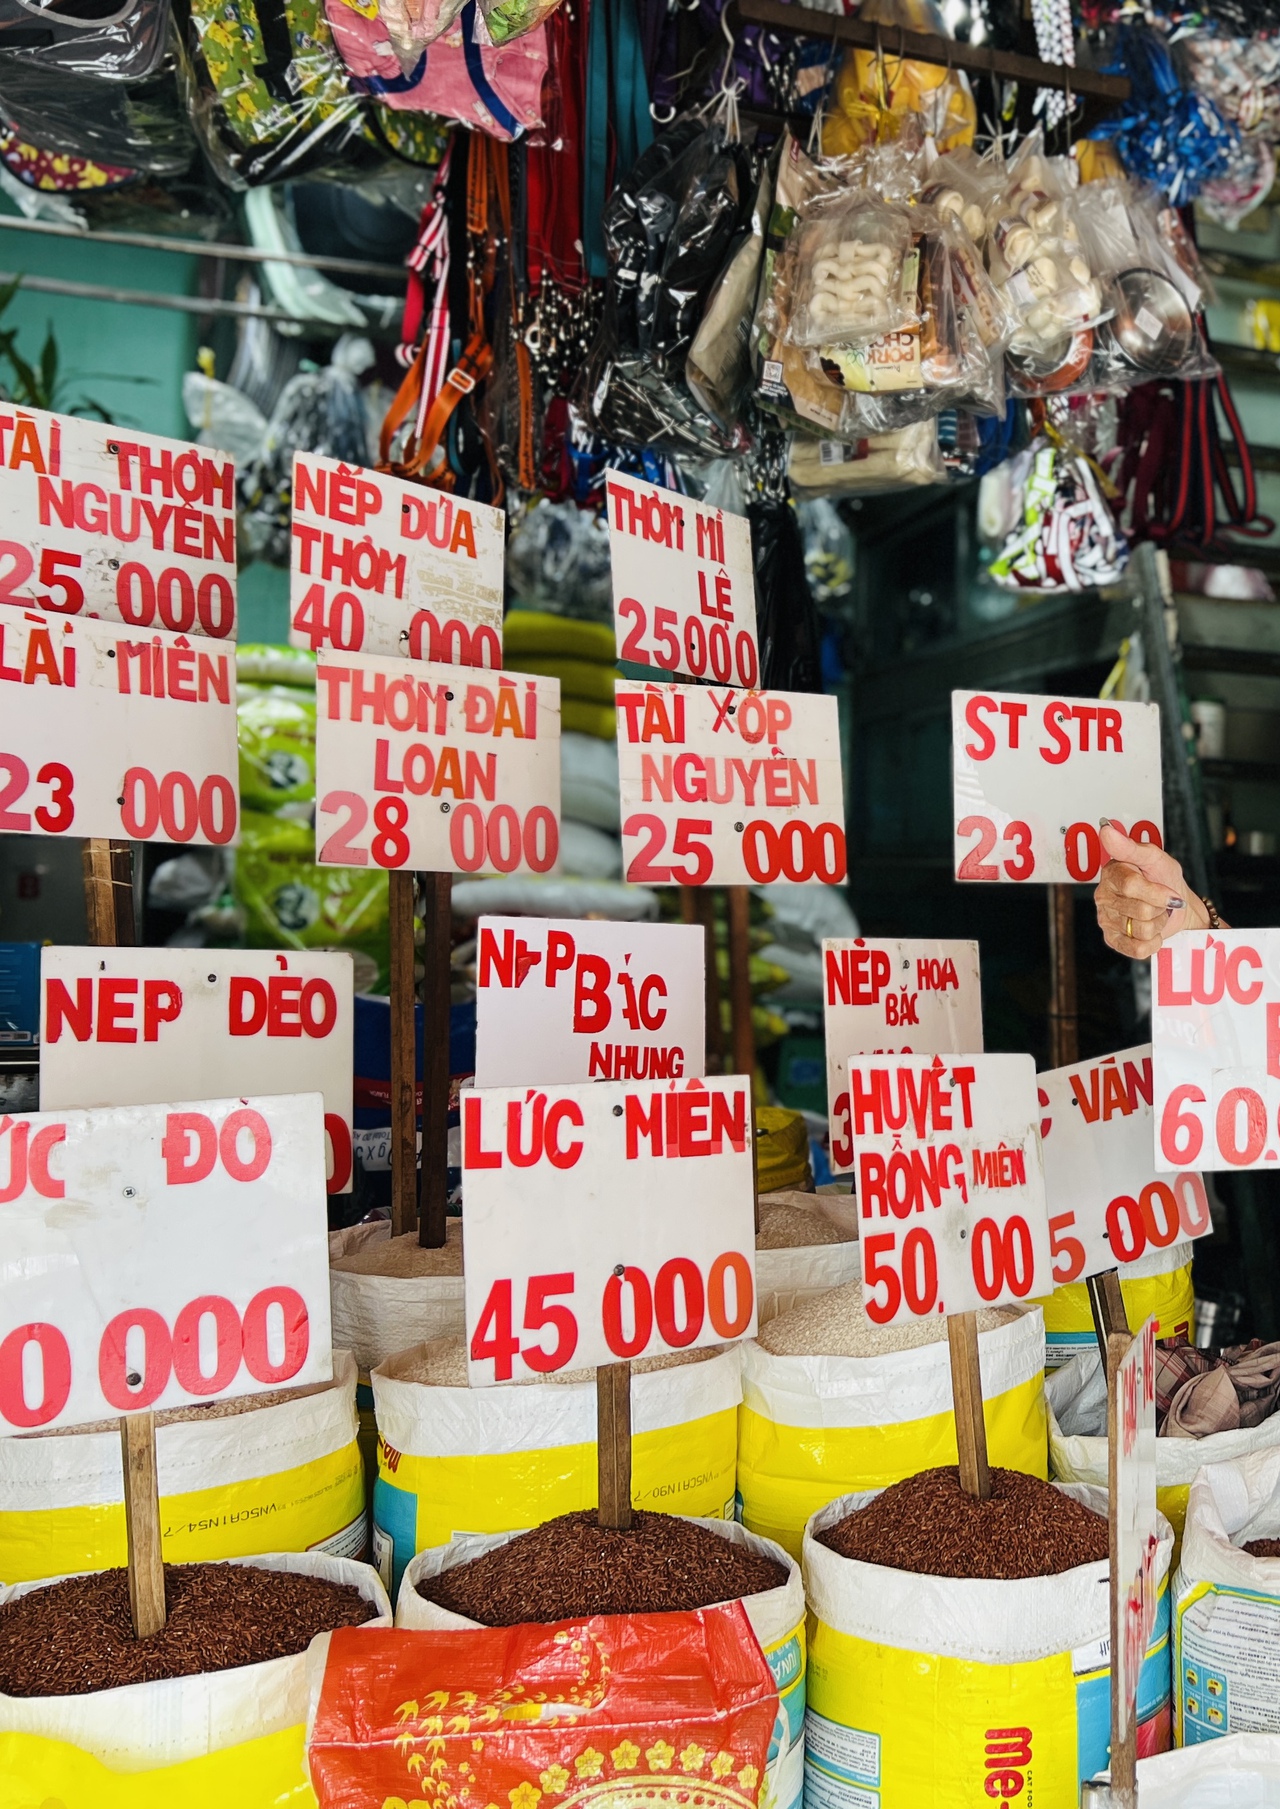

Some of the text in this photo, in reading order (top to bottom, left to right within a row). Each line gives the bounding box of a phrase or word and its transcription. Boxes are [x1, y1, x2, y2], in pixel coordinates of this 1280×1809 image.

[34, 476, 235, 563] NGUYÊN
[294, 461, 477, 559] NẾP DỨA
[115, 561, 235, 638] 000
[291, 523, 406, 600] THƠM
[292, 583, 503, 671] 40 000
[618, 597, 758, 688] 25000
[116, 635, 231, 705] MIÊN
[317, 665, 538, 740] THƠM ĐÀI
[614, 683, 686, 744] TÀI
[965, 695, 1123, 765] ST STR
[0, 753, 237, 845] 23 000
[374, 738, 497, 802] LOAN
[641, 746, 819, 808] NGUYÊN
[320, 791, 559, 873] 28 000
[622, 813, 847, 887] 25 000
[957, 816, 1036, 881] 23
[916, 958, 960, 992] HOA
[1154, 935, 1264, 1006] LỨC
[588, 1041, 685, 1080] NHUNG
[464, 1077, 747, 1170] LỨC MIÊN
[1105, 1172, 1209, 1263] 000
[98, 1286, 310, 1411] 000
[470, 1251, 754, 1381] 45 000
[1026, 1789, 1034, 1809] FOO
